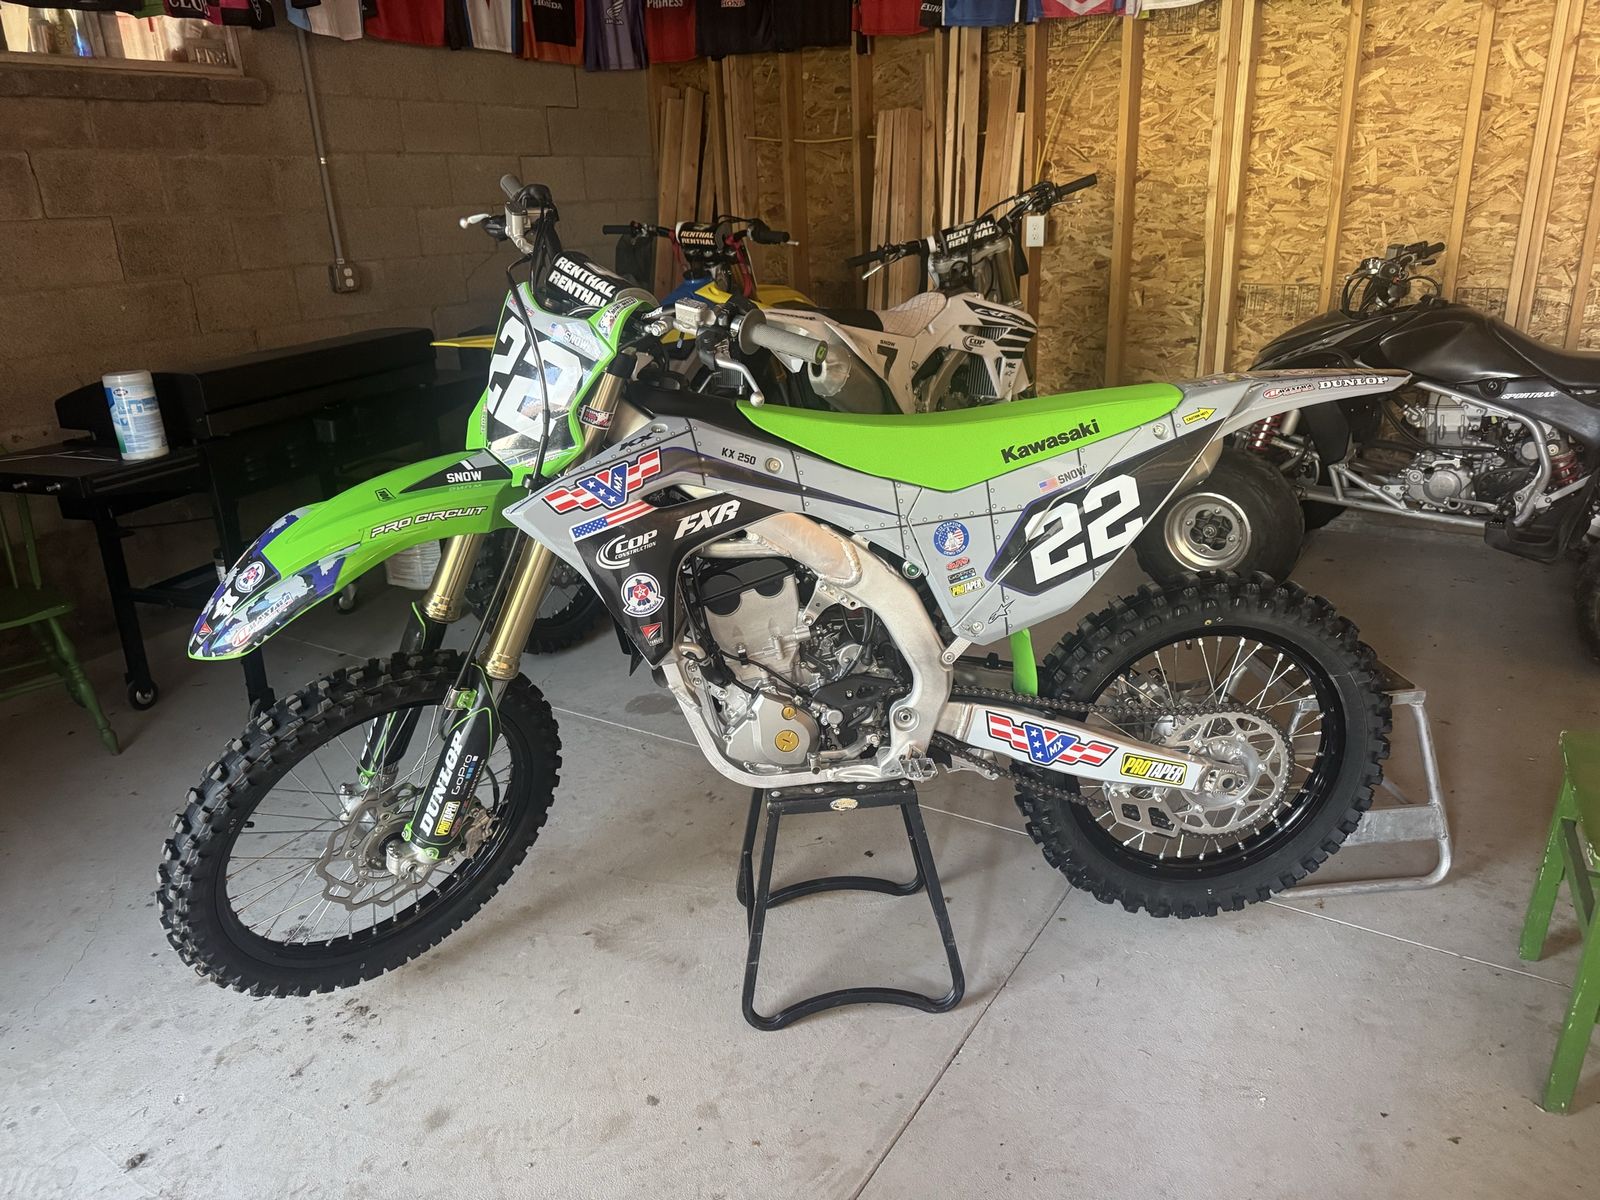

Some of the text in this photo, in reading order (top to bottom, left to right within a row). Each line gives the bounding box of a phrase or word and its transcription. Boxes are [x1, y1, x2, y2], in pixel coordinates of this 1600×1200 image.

[680, 230, 714, 238] RENTHAL
[681, 238, 715, 246] RENTHAL
[948, 227, 996, 249] RENHAL
[555, 256, 616, 298] RENTHAL
[564, 329, 592, 351] SNOW
[877, 344, 898, 382] 7
[1318, 376, 1389, 390] DUNLOP
[1500, 390, 1560, 400] SPORTRAX
[1000, 418, 1101, 464] Kawasaki
[721, 447, 757, 465] KX 250
[446, 470, 482, 483] SNOW
[613, 472, 623, 492] MX
[1058, 465, 1087, 484] SNOW
[370, 506, 488, 538] PRO CIRCUIT
[673, 499, 741, 541] FXR
[1024, 473, 1144, 585] 22
[614, 541, 657, 560] CONSTRUCTION
[615, 529, 658, 554] COP
[1049, 739, 1064, 757] MX
[419, 730, 463, 837] DUNLOP
[451, 754, 473, 795] GoPro
